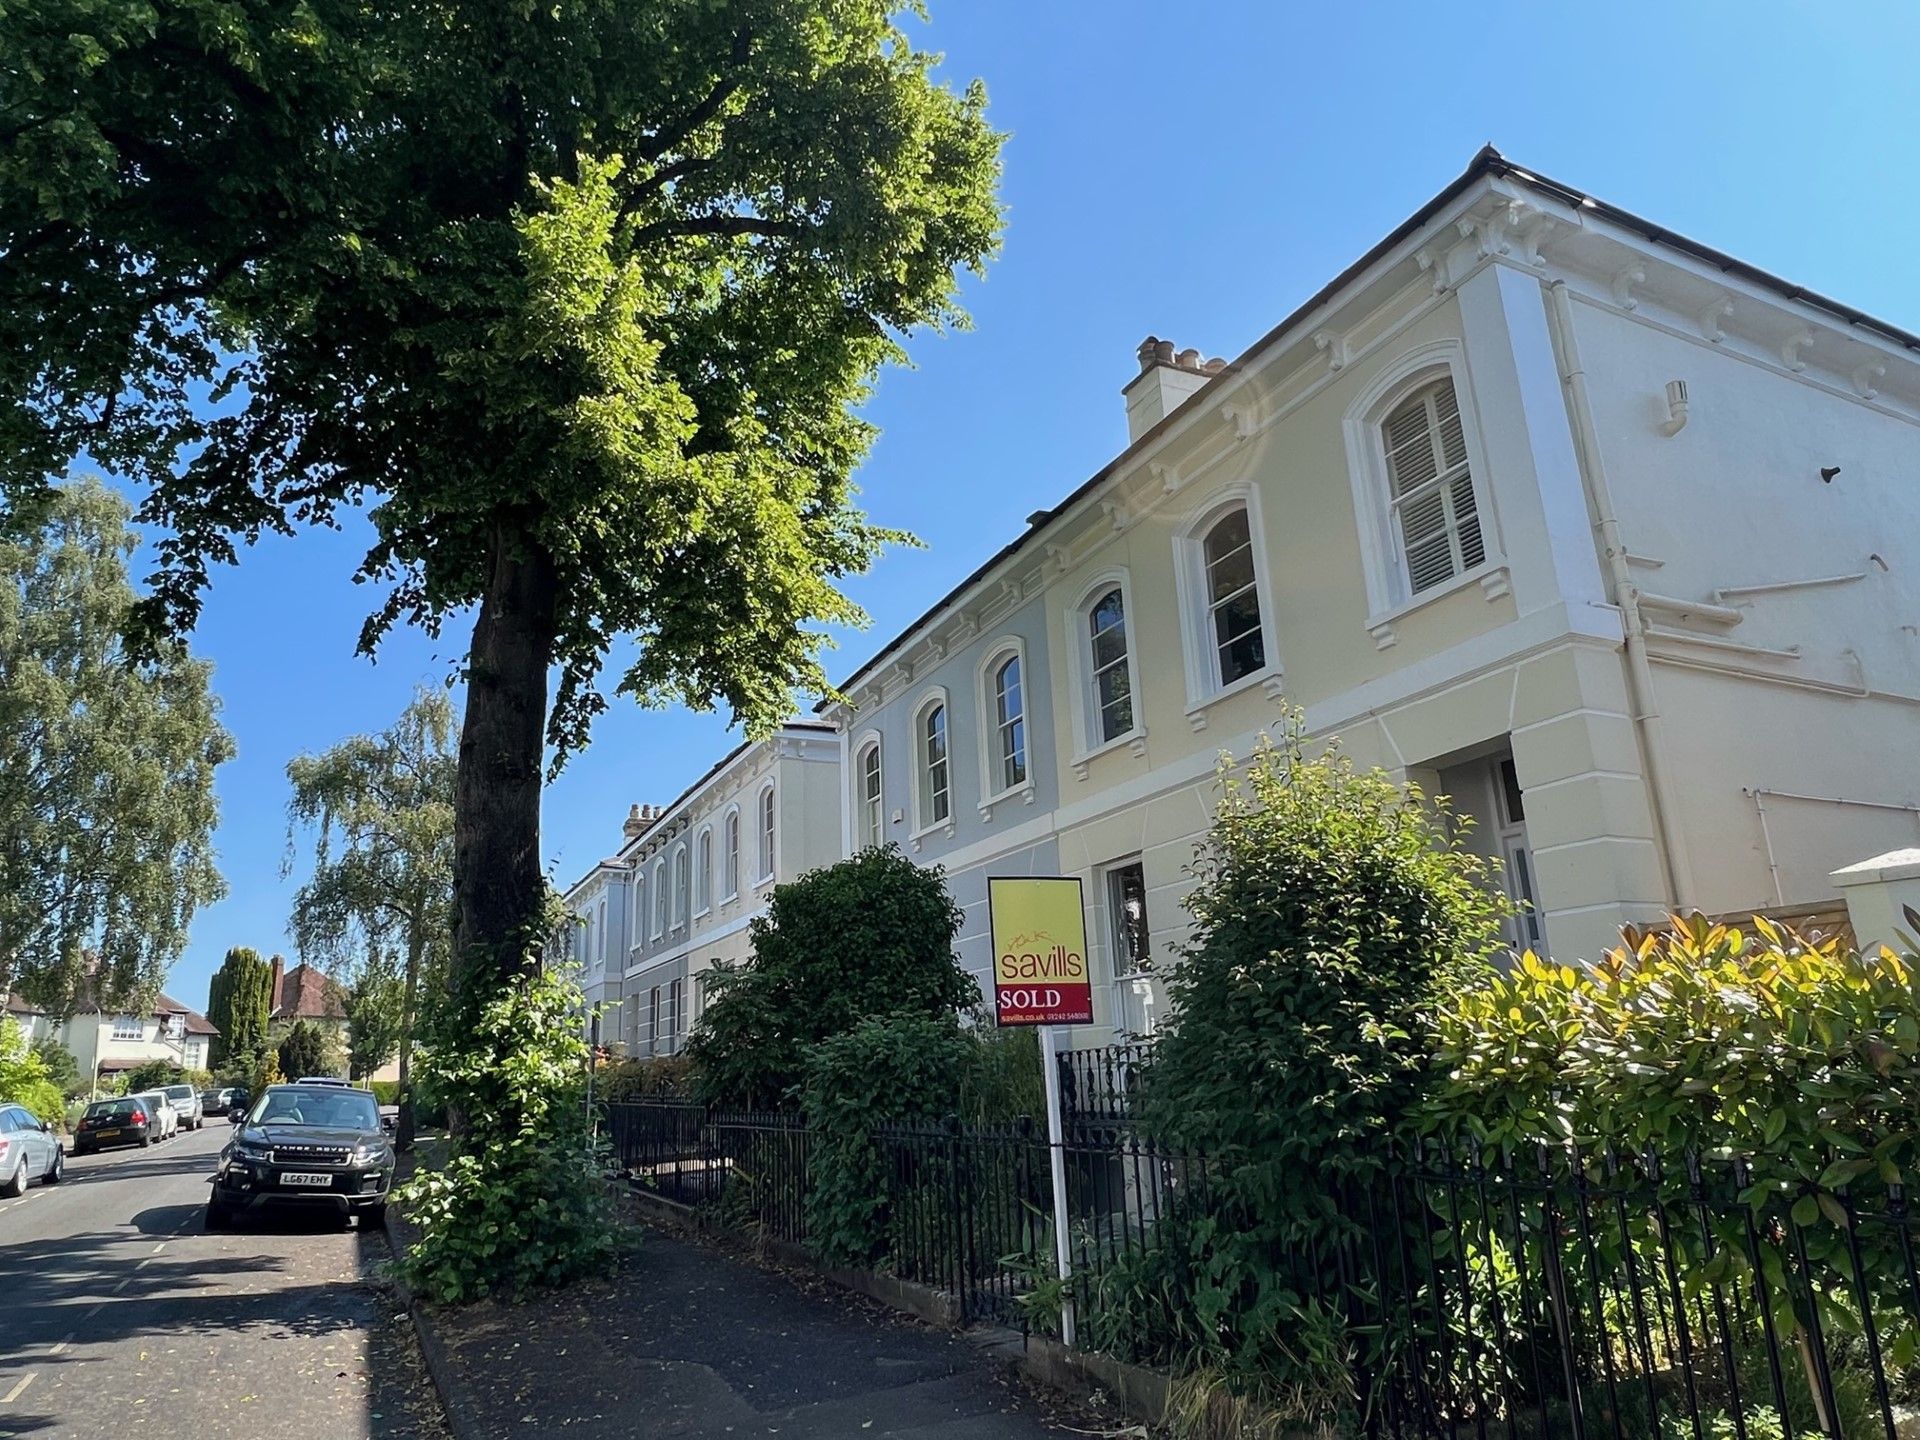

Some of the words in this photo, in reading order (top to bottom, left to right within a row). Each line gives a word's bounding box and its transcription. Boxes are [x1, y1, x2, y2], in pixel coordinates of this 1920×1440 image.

[1001, 945, 1082, 979] savills
[1000, 989, 1061, 1009] SOLD
[284, 1174, 309, 1183] LG67
